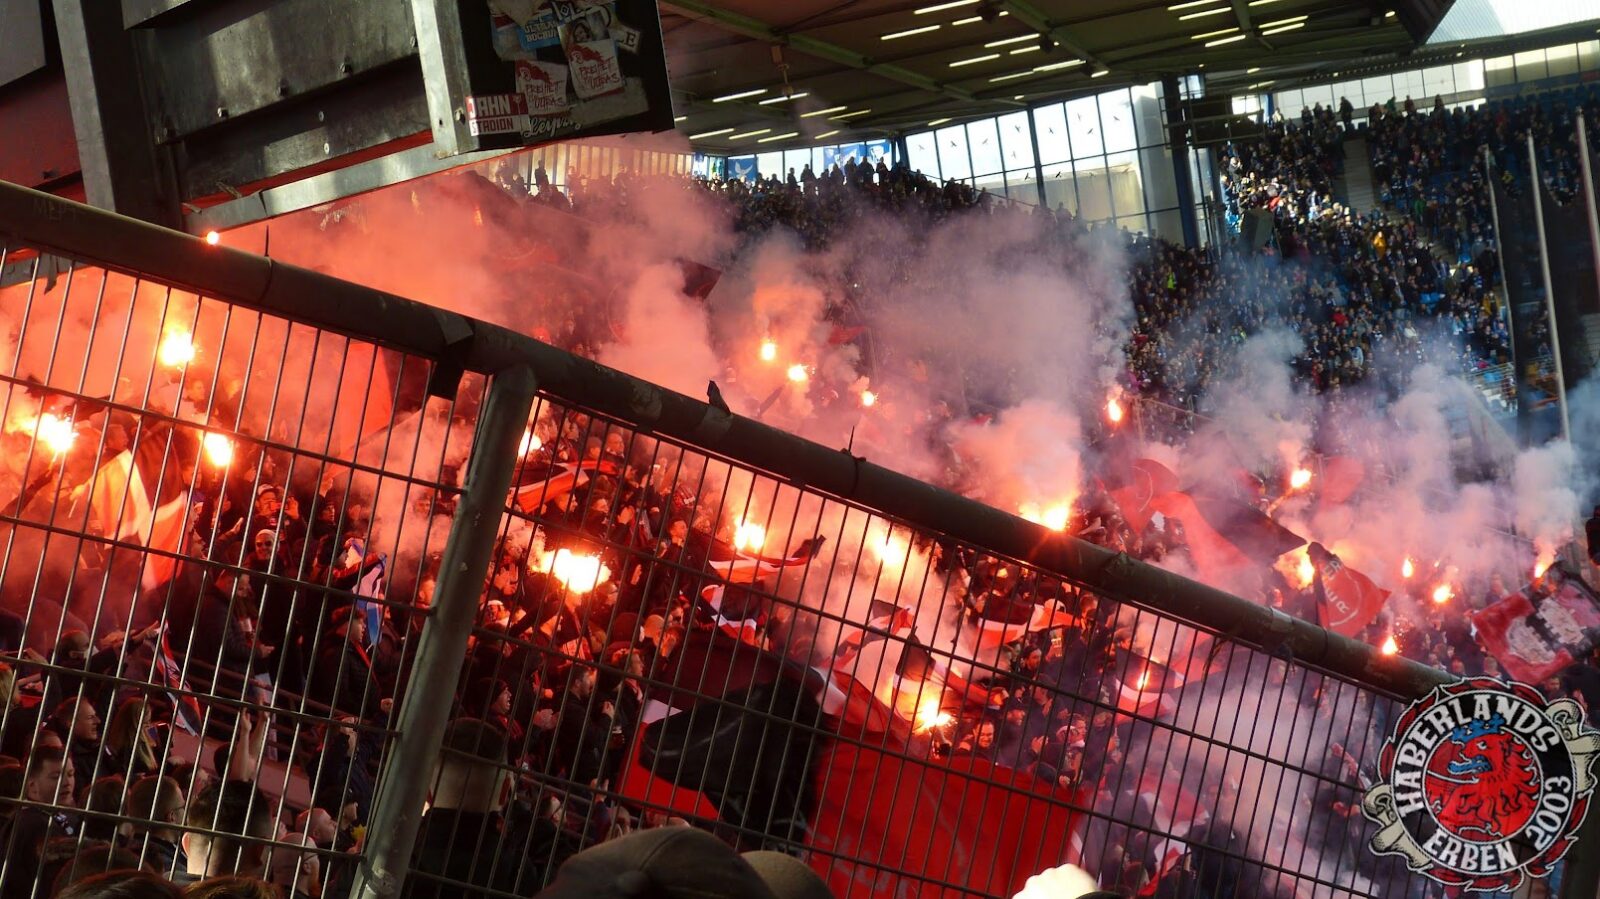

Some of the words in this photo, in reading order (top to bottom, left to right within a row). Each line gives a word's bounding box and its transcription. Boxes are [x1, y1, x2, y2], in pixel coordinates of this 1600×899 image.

[466, 94, 512, 119] JAHN
[471, 117, 514, 134] STADION
[523, 116, 582, 138] Leipz
